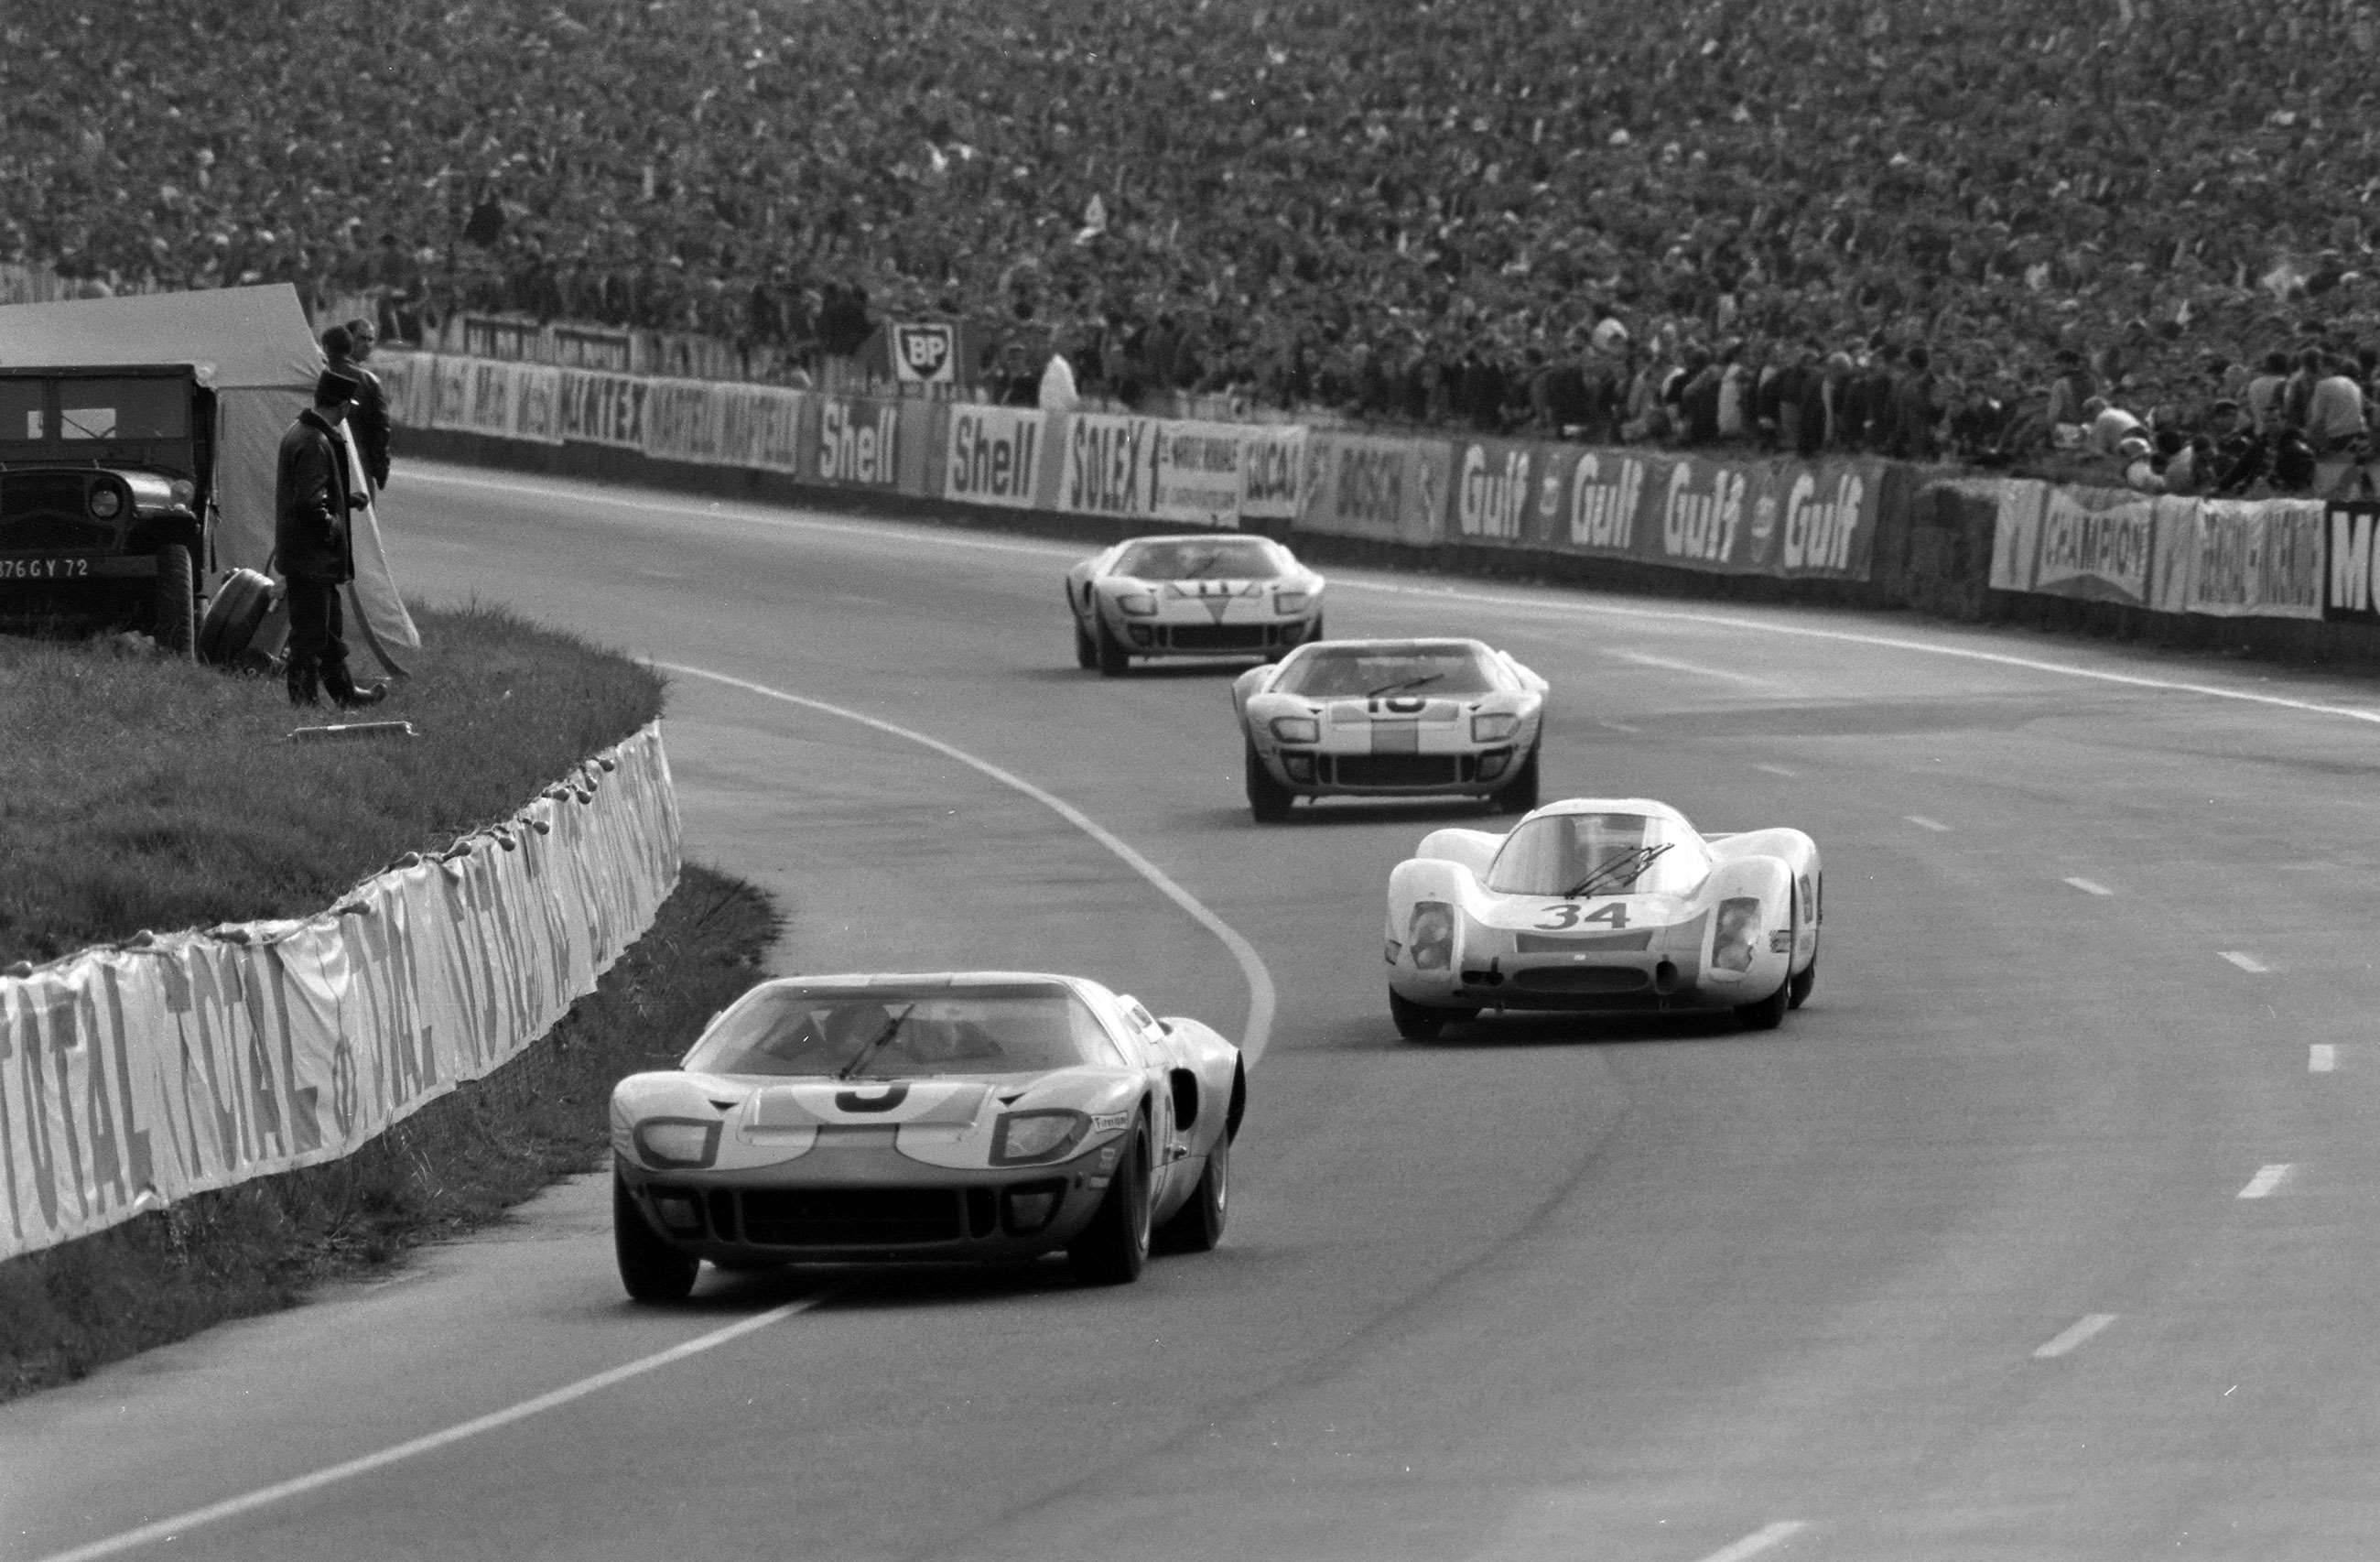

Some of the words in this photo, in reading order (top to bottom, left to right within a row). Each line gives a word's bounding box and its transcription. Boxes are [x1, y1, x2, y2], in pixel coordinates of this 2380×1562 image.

[908, 335, 946, 365] BP
[820, 402, 897, 483] Shell
[954, 415, 1036, 497] Shell
[1072, 417, 1145, 512] SOLEX
[1460, 443, 1531, 539] Gulf
[1571, 452, 1644, 549] Gulf
[1664, 461, 1746, 564] Gulf
[1786, 472, 1863, 570] Gulf
[65, 559, 88, 576] 72
[2045, 511, 2147, 578] CHAMPION
[2331, 510, 2380, 616] M
[1532, 901, 1631, 931] 34
[160, 944, 323, 1174] TOTAL
